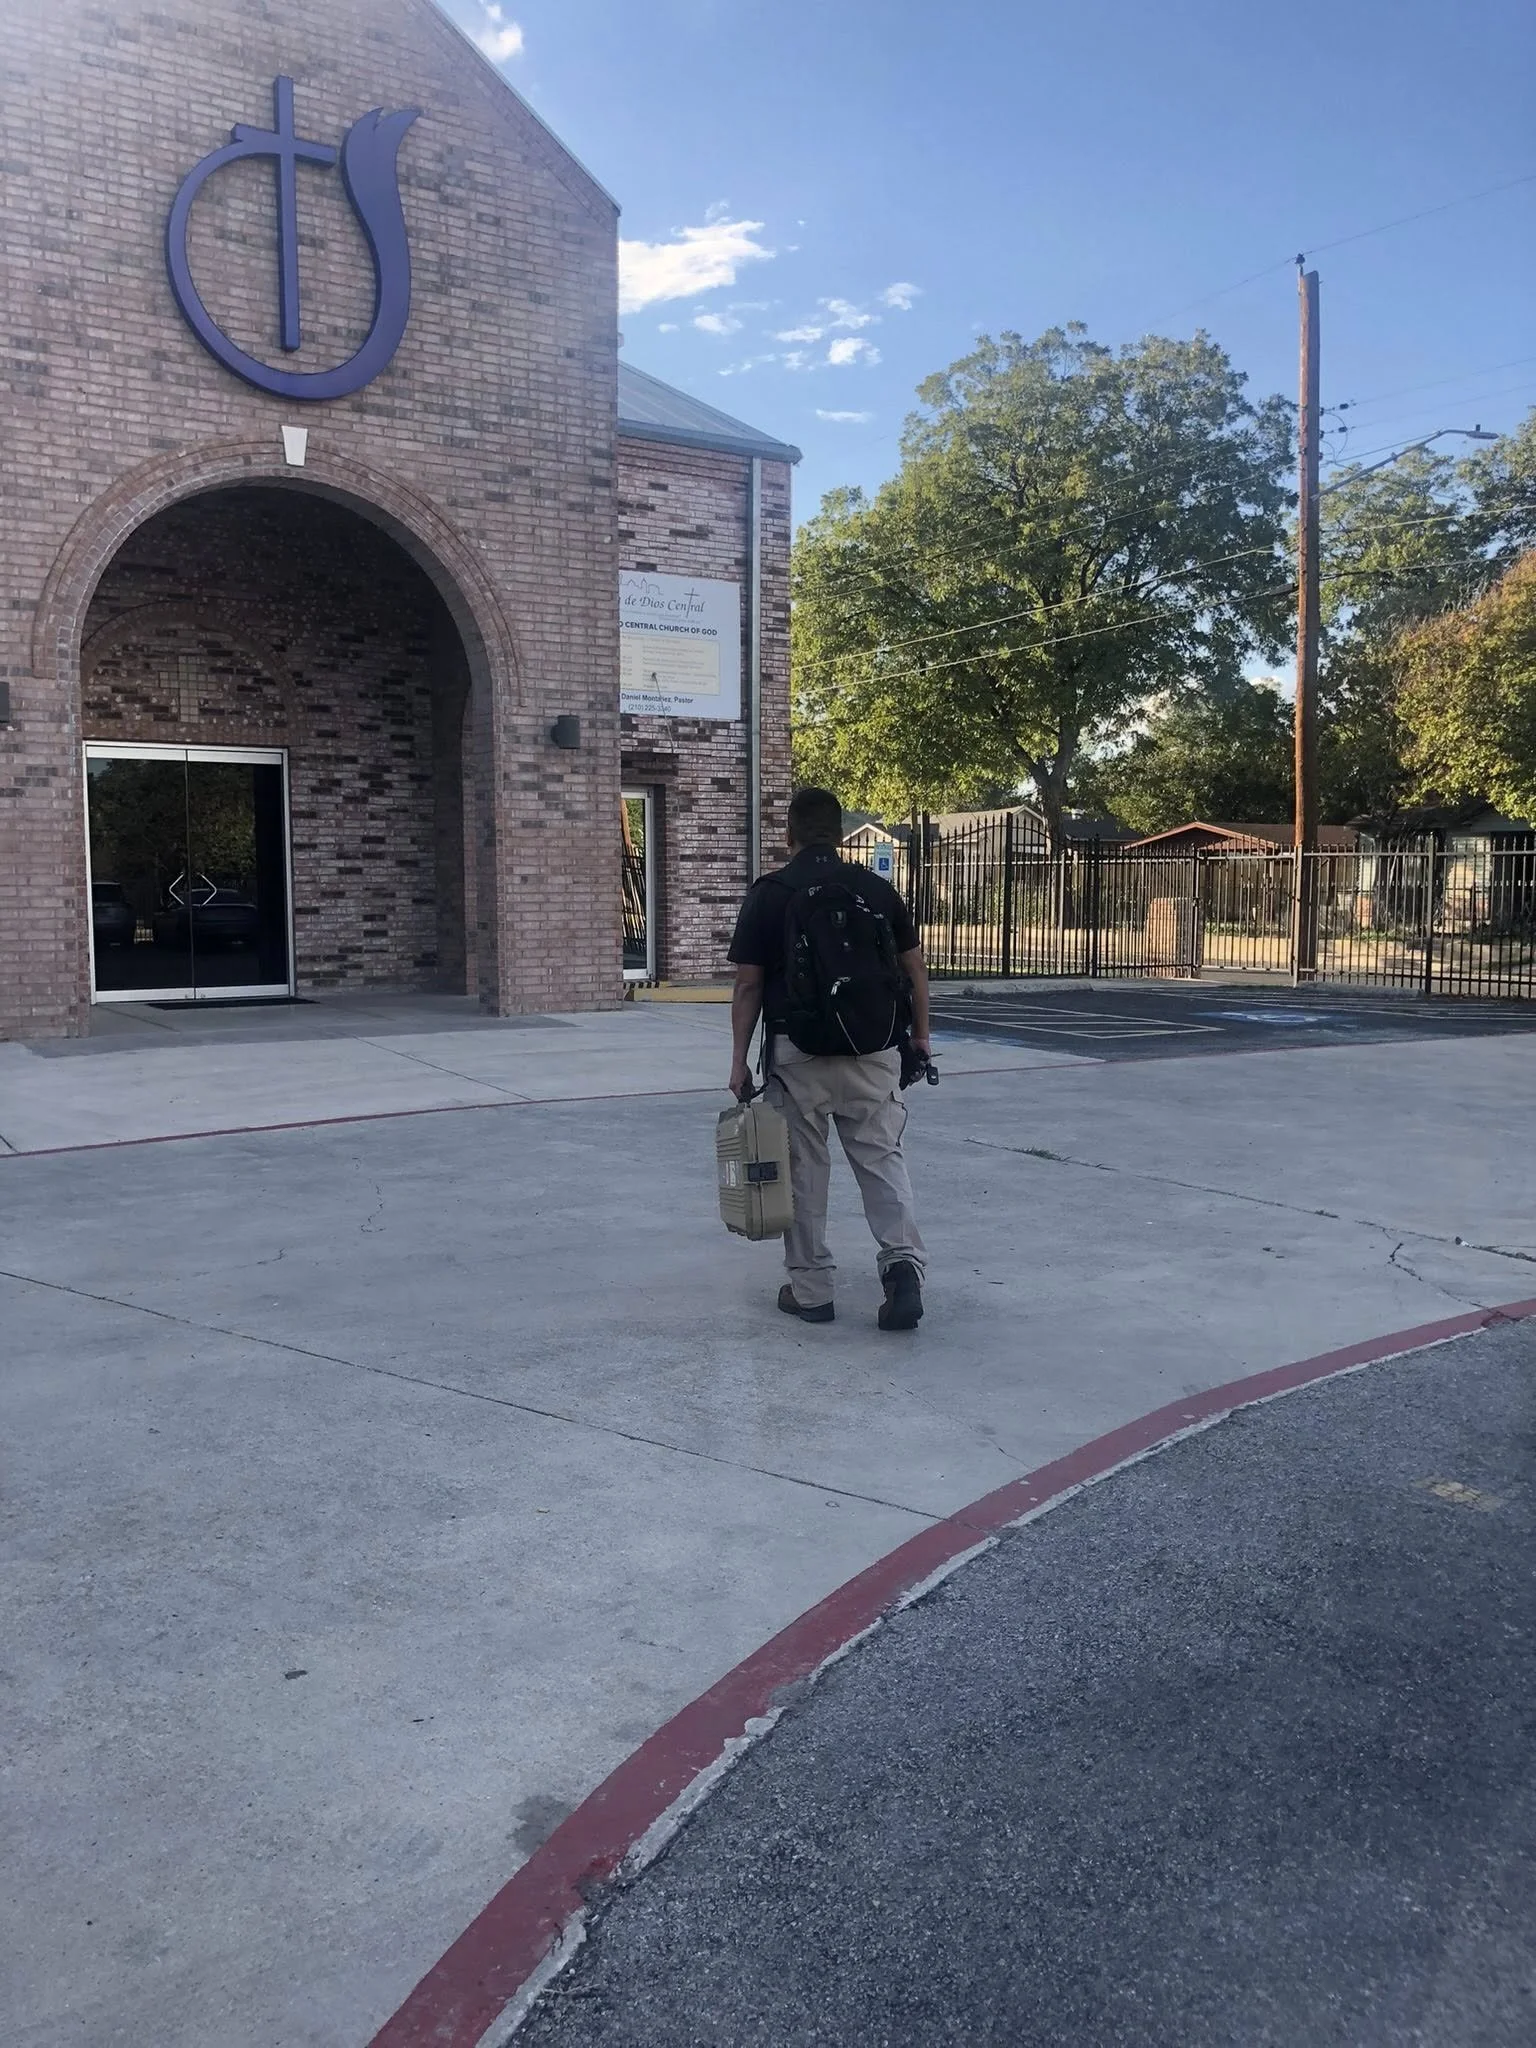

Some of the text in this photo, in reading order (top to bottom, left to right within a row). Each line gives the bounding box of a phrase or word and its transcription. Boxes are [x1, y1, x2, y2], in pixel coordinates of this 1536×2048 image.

[625, 594, 637, 606] de
[640, 596, 665, 608] Dios
[625, 621, 658, 630] CENTRAL
[659, 624, 690, 633] CHURCH
[701, 628, 718, 636] GOD
[621, 692, 641, 701] Daniel
[673, 696, 694, 705] Pastor
[628, 703, 644, 712] (210)
